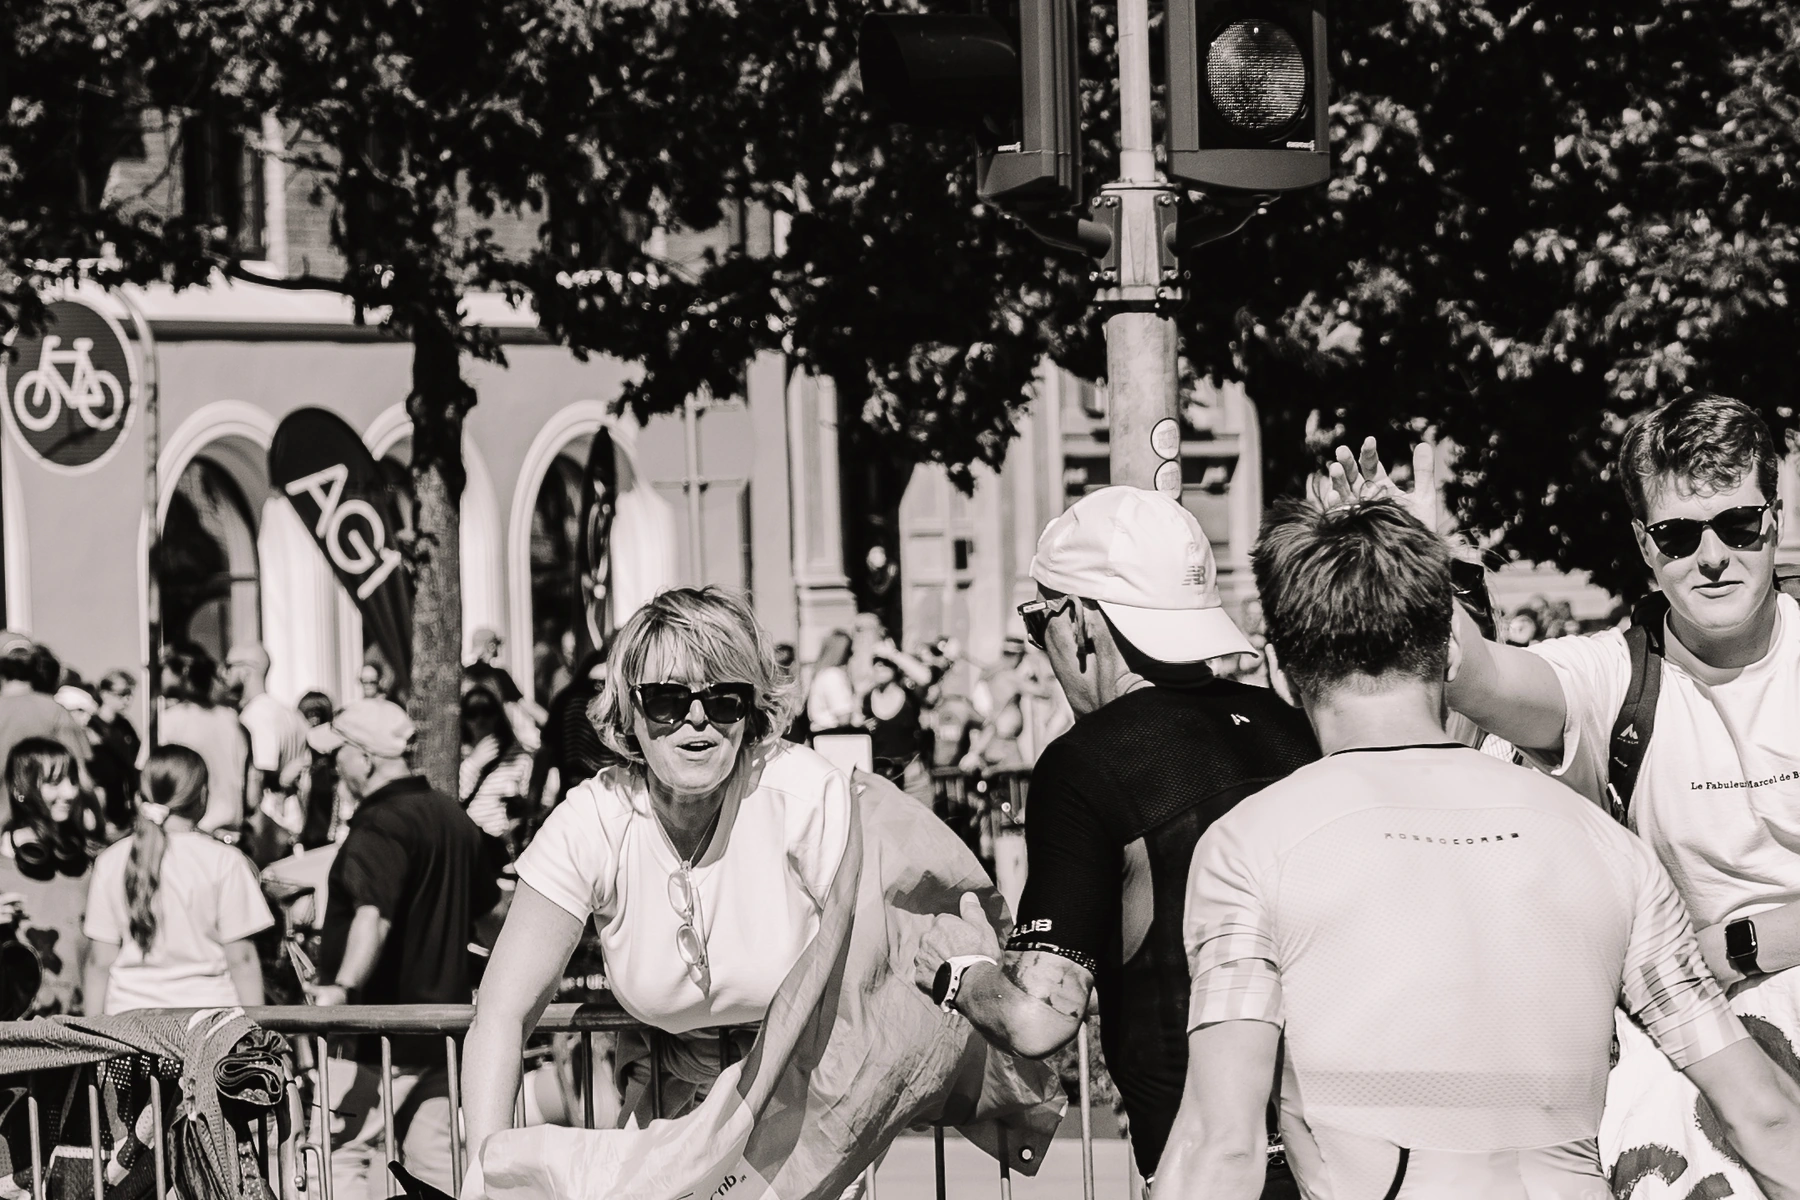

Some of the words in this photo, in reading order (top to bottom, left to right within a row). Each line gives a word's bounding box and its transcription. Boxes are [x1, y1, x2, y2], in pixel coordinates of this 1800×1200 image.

[285, 463, 402, 601] AG1
[1691, 782, 1703, 790] Le
[1779, 773, 1791, 782] de
